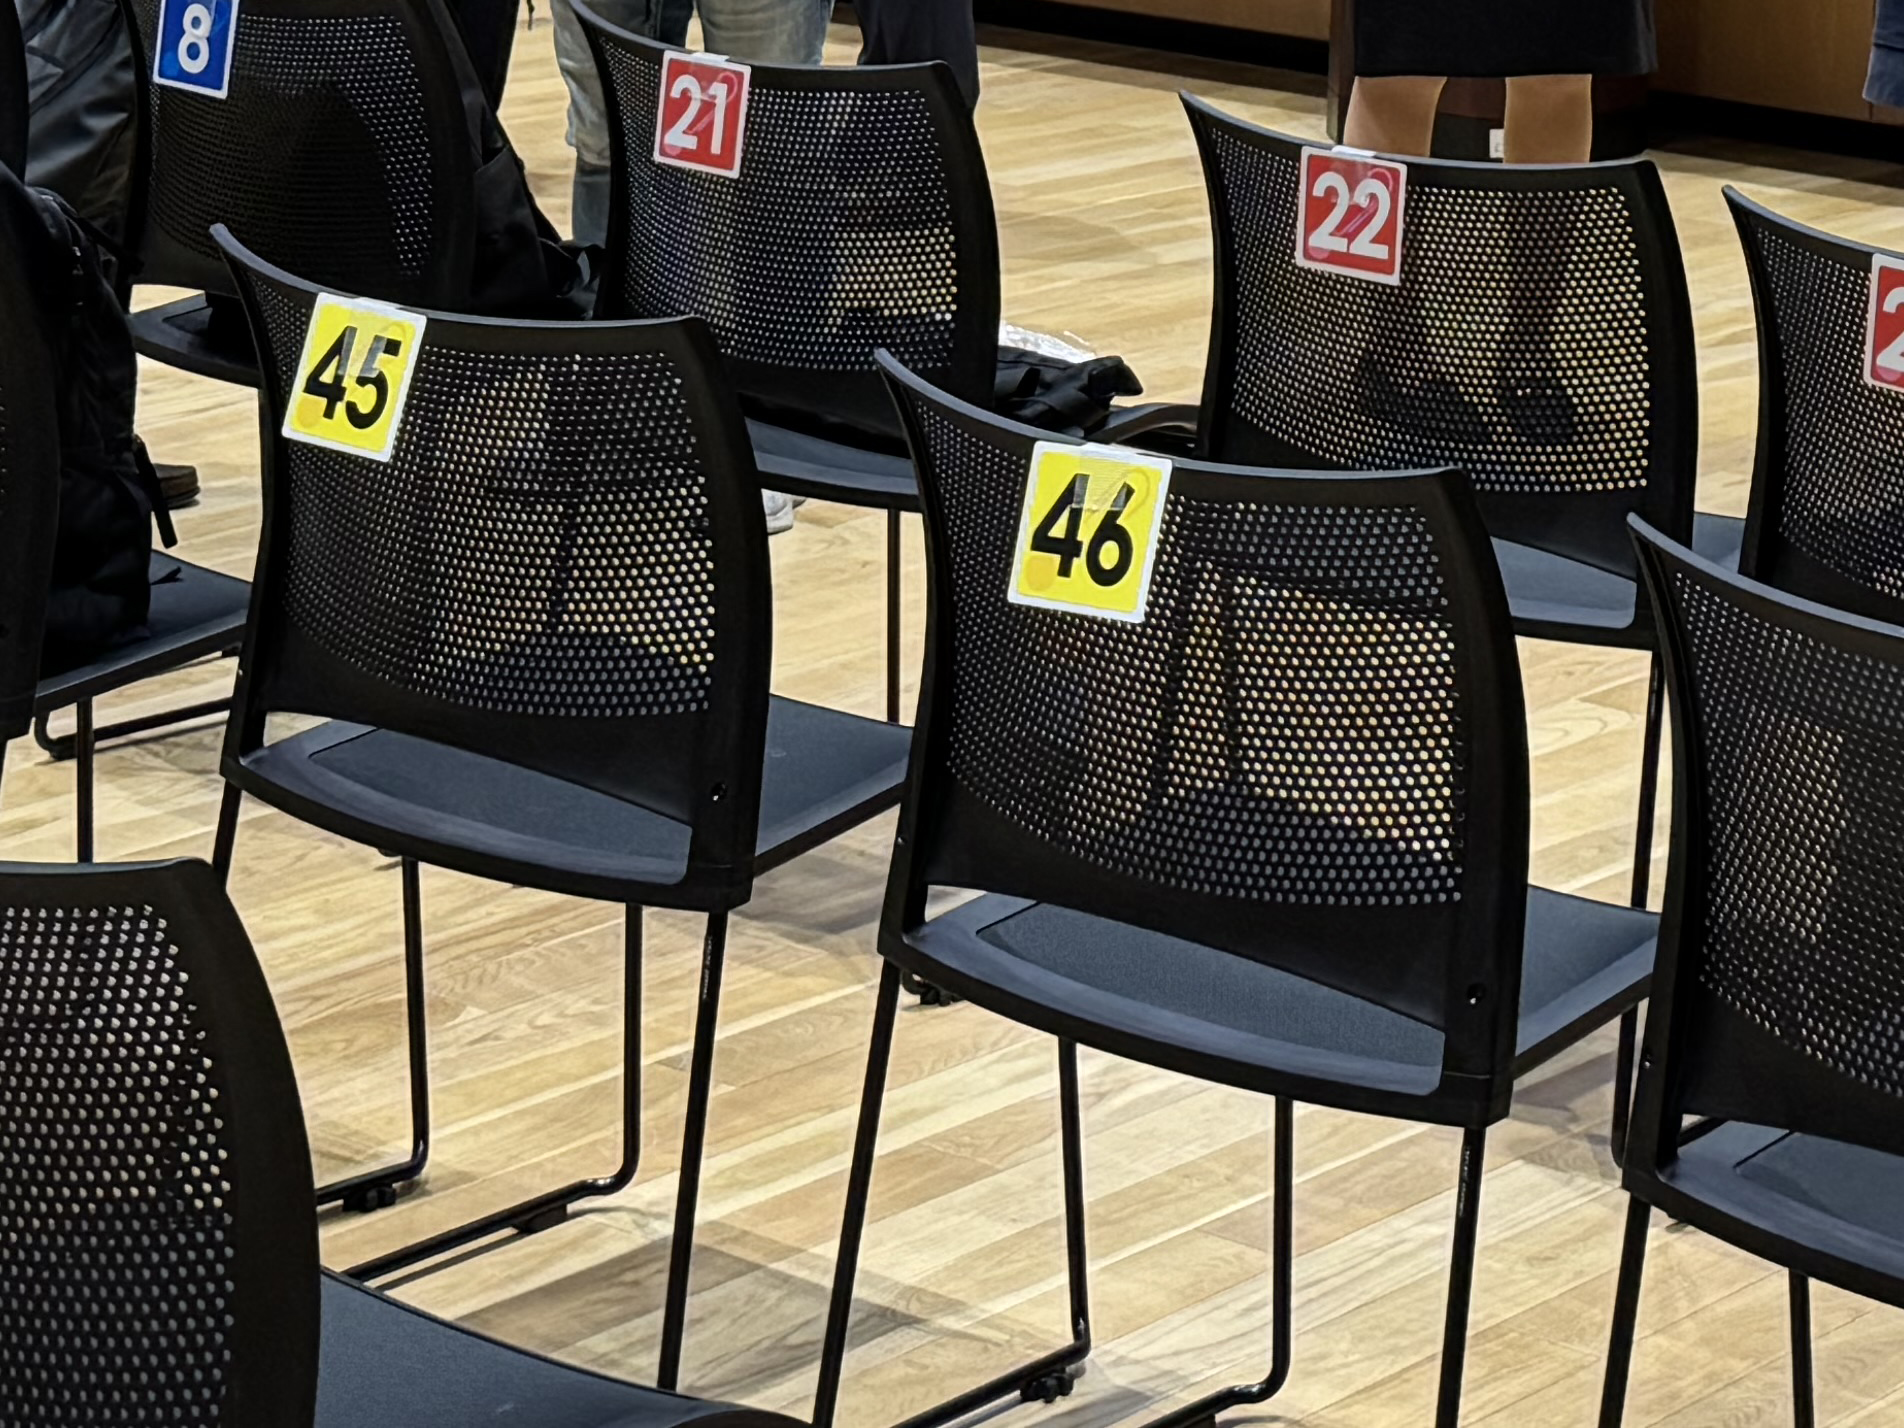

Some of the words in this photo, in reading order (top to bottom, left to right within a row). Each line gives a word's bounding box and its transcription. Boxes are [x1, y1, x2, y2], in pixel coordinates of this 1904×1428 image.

[177, 3, 212, 74] 8
[664, 75, 728, 155] 21
[1308, 171, 1391, 259] 22
[302, 326, 403, 430] 45
[1030, 472, 1136, 587] 46
